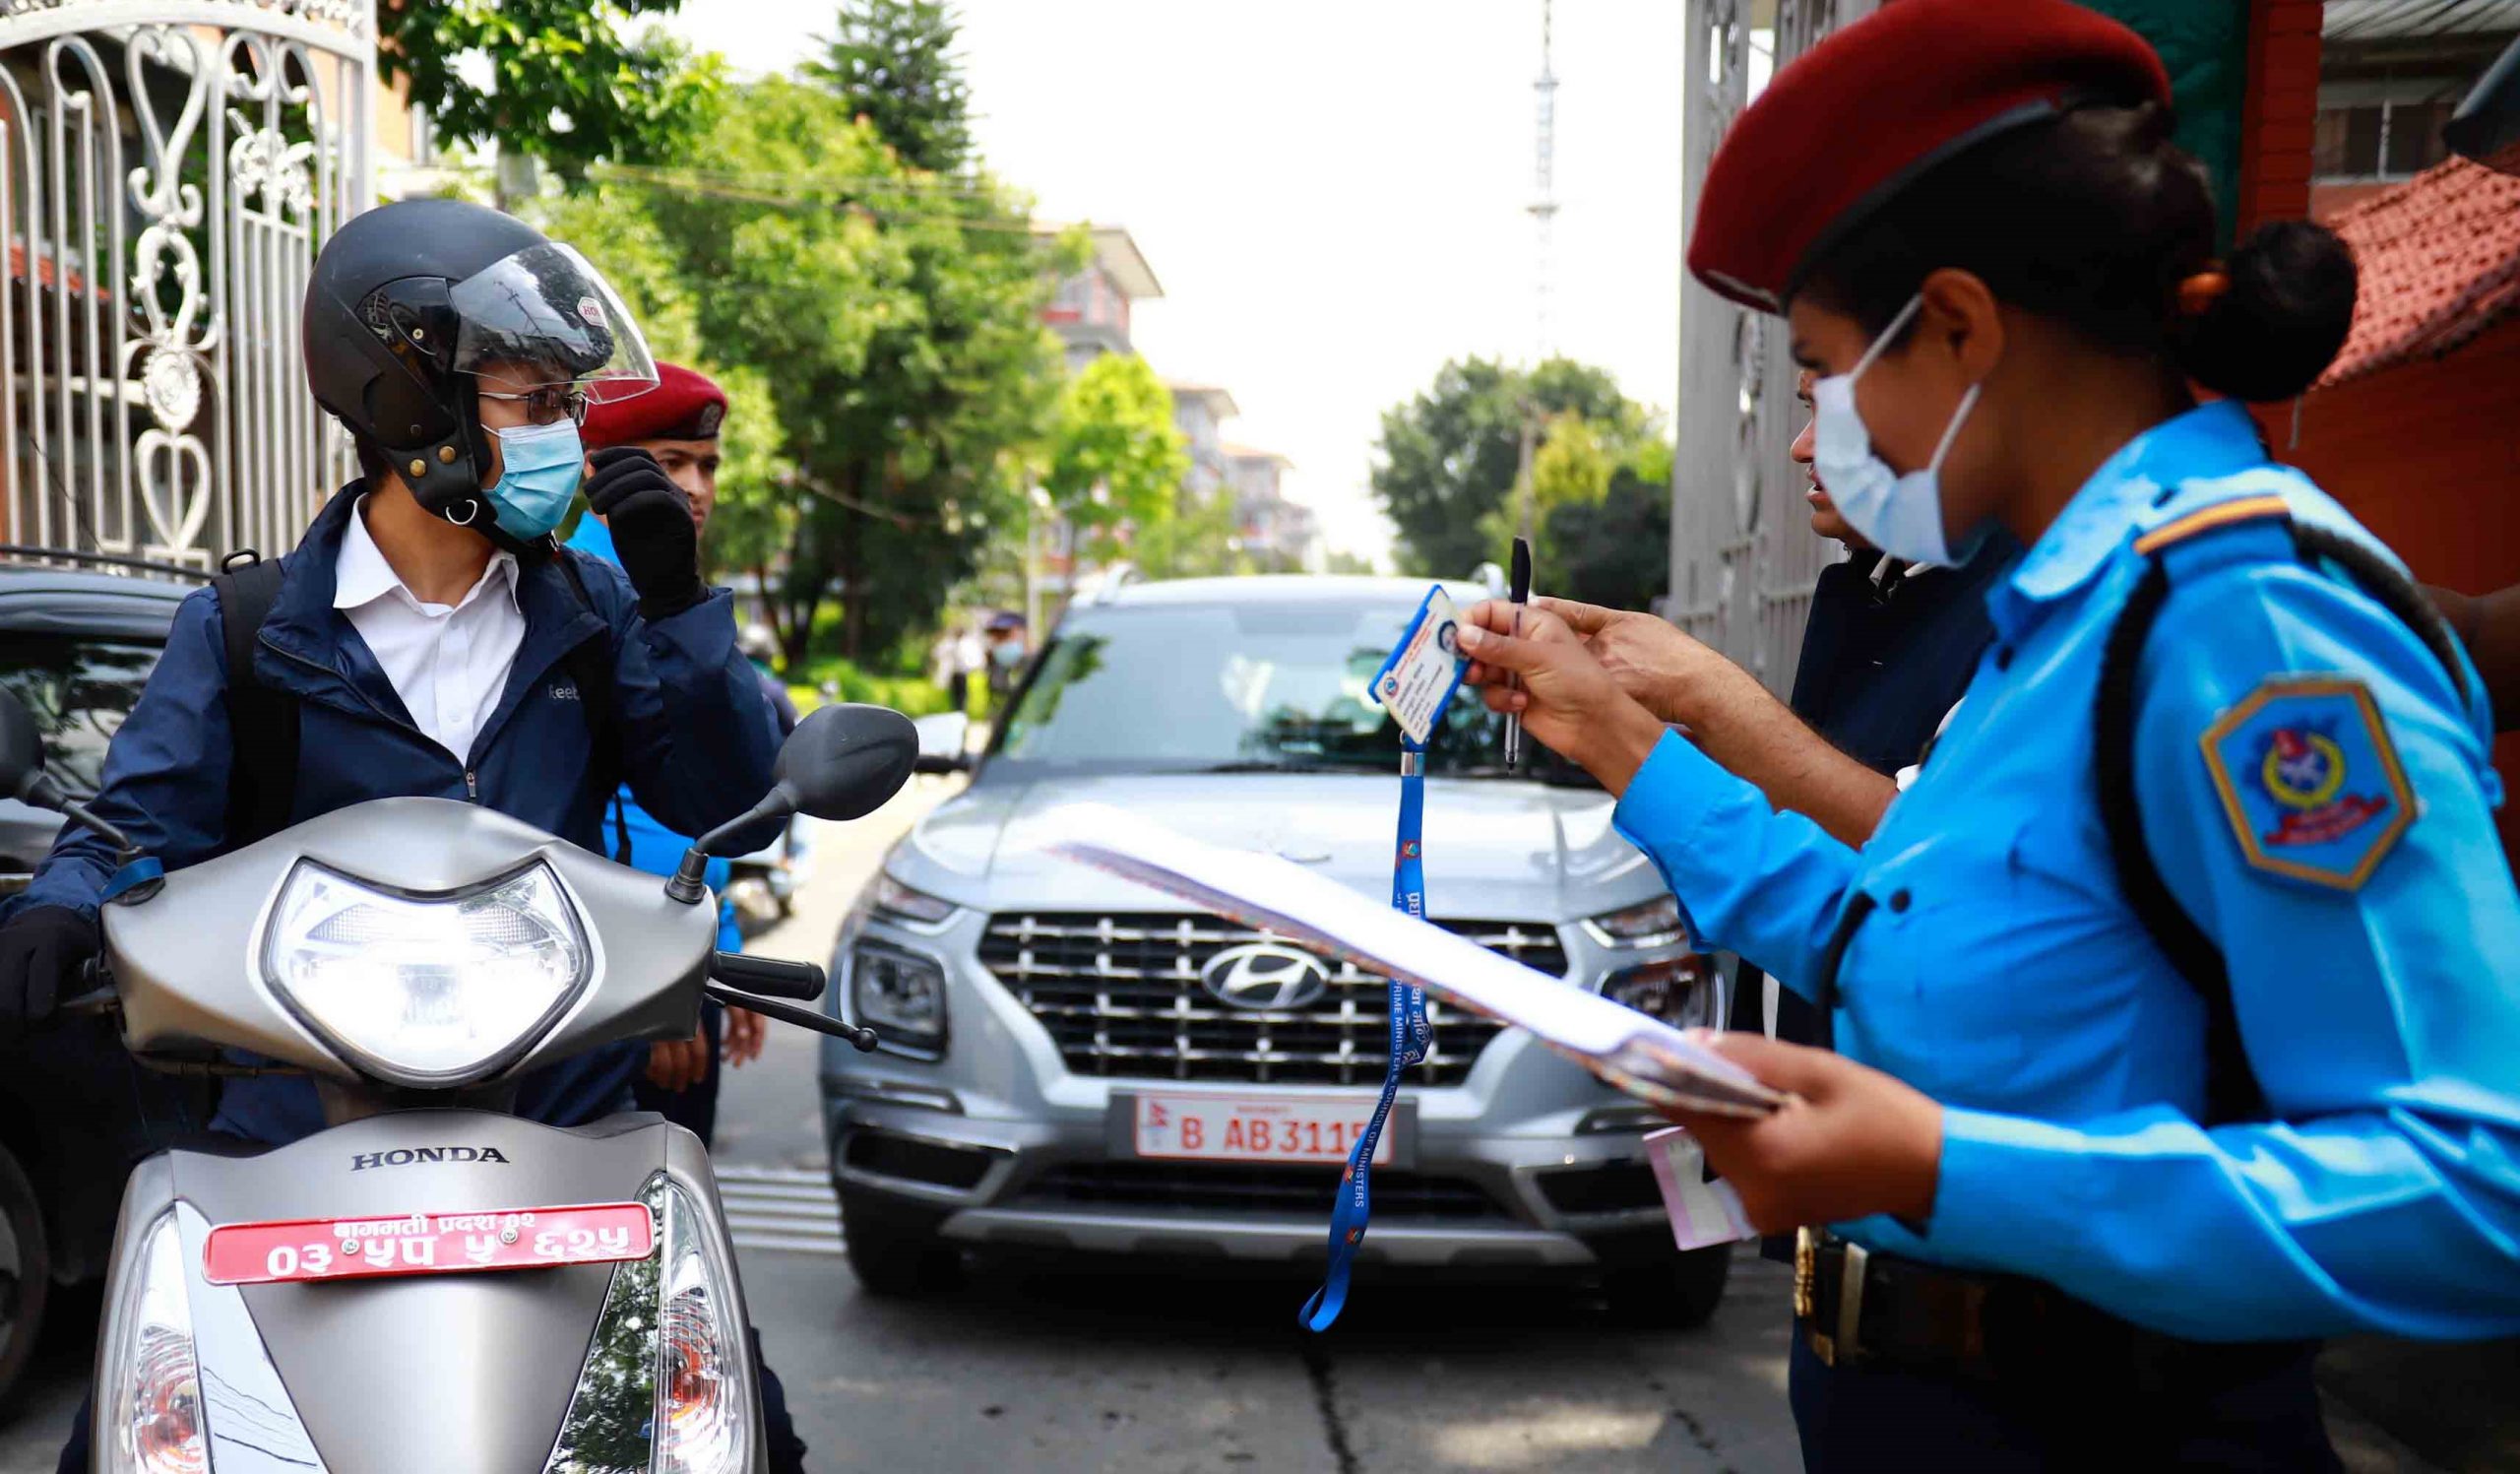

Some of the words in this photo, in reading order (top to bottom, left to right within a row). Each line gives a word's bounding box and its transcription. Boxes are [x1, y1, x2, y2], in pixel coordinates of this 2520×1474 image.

[1394, 978, 1403, 1014] PRIME
[1393, 1017, 1403, 1071] MINISTER
[1373, 1085, 1396, 1130] COUNCIL
[1181, 1117, 1204, 1151] B
[1367, 1132, 1377, 1144] OF
[350, 1146, 510, 1171] HONDA
[1354, 1147, 1369, 1208] MINISTERS
[334, 1213, 428, 1238] बागमती
[267, 1244, 333, 1276] ०३
